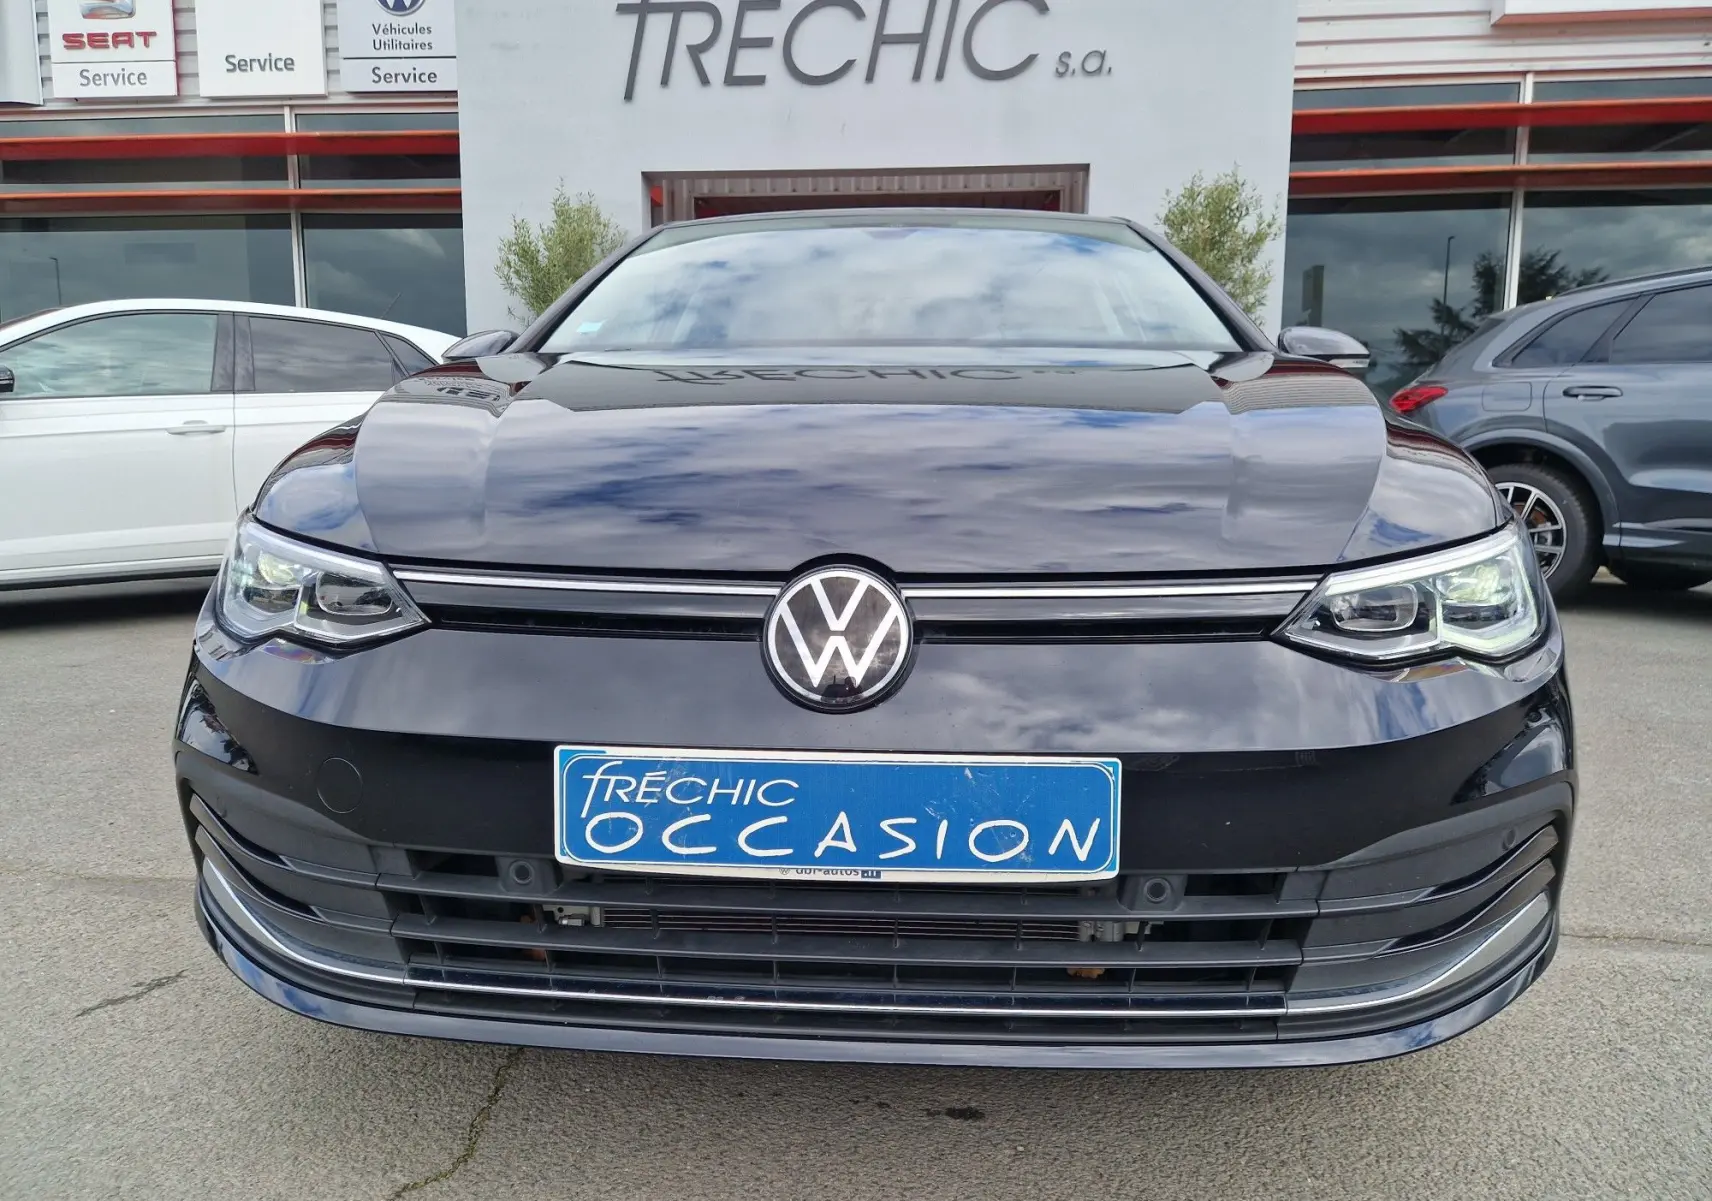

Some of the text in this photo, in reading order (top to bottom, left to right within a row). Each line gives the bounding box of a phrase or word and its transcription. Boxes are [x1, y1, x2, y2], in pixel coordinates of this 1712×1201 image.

[372, 22, 432, 36] Véhicules
[62, 31, 157, 50] SEAT
[373, 38, 433, 51] Utilitaires
[224, 52, 295, 73] Service
[79, 67, 148, 87] Service
[372, 66, 438, 84] Service
[584, 810, 1100, 862] OCCASION
